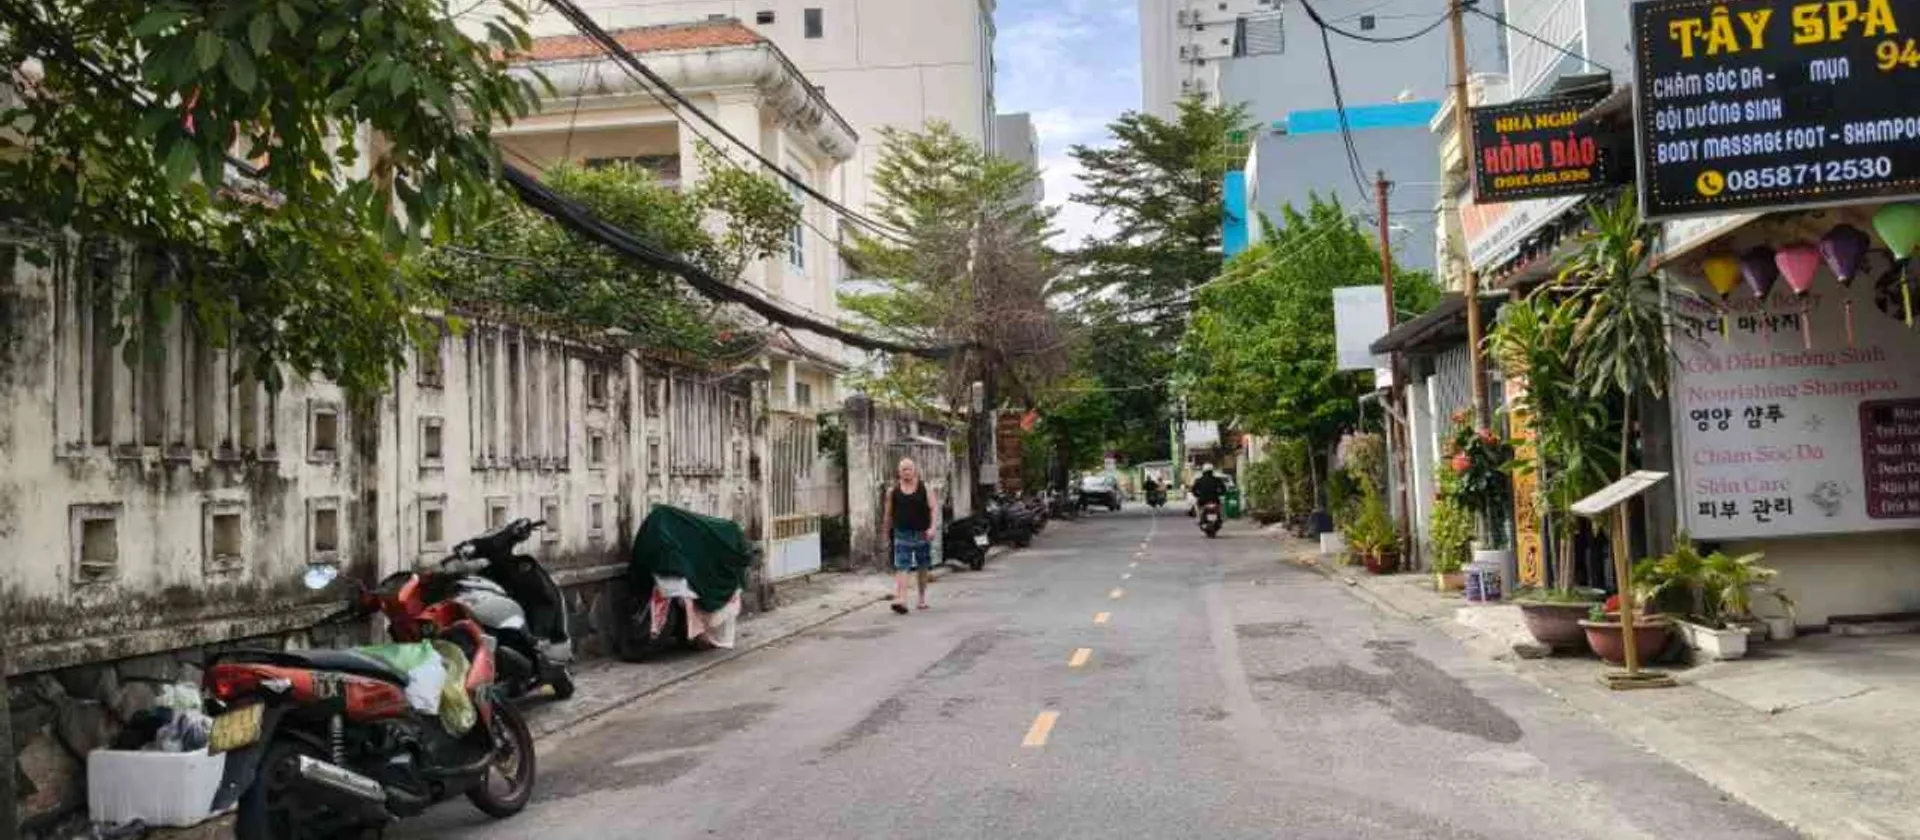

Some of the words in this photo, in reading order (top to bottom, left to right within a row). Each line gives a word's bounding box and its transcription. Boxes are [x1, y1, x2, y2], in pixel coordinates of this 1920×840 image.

[1669, 5, 1774, 58] TÂY
[1792, 0, 1898, 45] SPA
[1741, 66, 1763, 90] DA
[1656, 139, 1700, 165] BODY
[1703, 131, 1784, 154] MASSAGE
[1785, 126, 1826, 151] FOOT
[1726, 156, 1892, 191] 0858712530
[1688, 382, 1798, 402] Nourishing
[1690, 408, 1733, 432] 영양
[1696, 477, 1742, 496] Skin
[1742, 476, 1790, 494] Care
[1698, 500, 1740, 519] 피부
[1752, 498, 1793, 522] 관리
